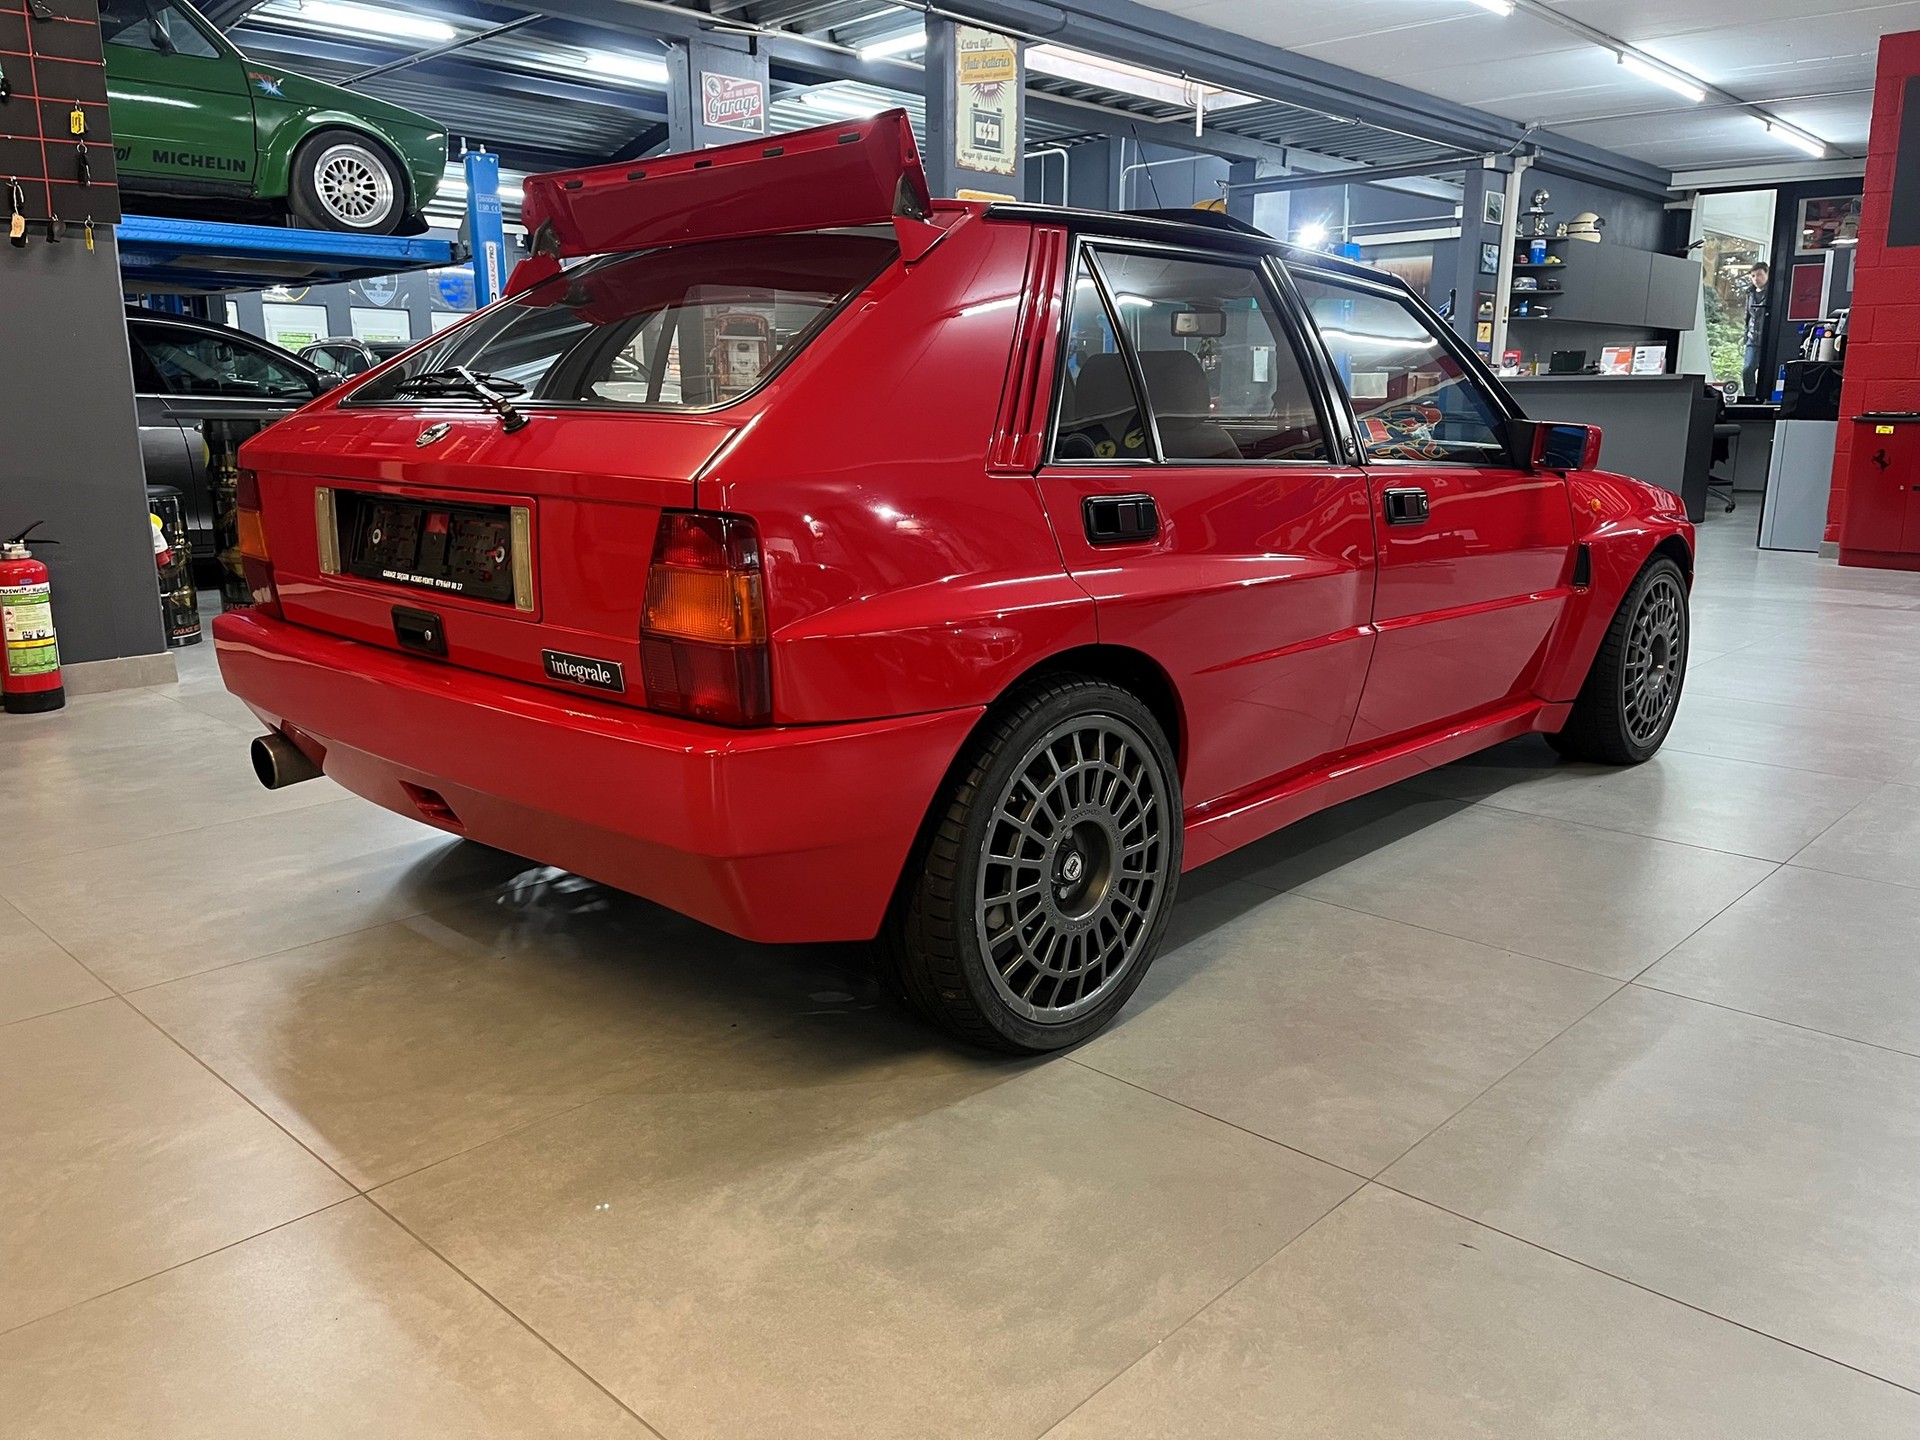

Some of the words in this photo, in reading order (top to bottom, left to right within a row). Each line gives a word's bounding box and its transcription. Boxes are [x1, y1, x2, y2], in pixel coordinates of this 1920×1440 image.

[961, 40, 979, 50] Extra
[708, 95, 760, 122] Garage
[153, 150, 246, 173] MICHELIN
[550, 654, 612, 683] integrale
